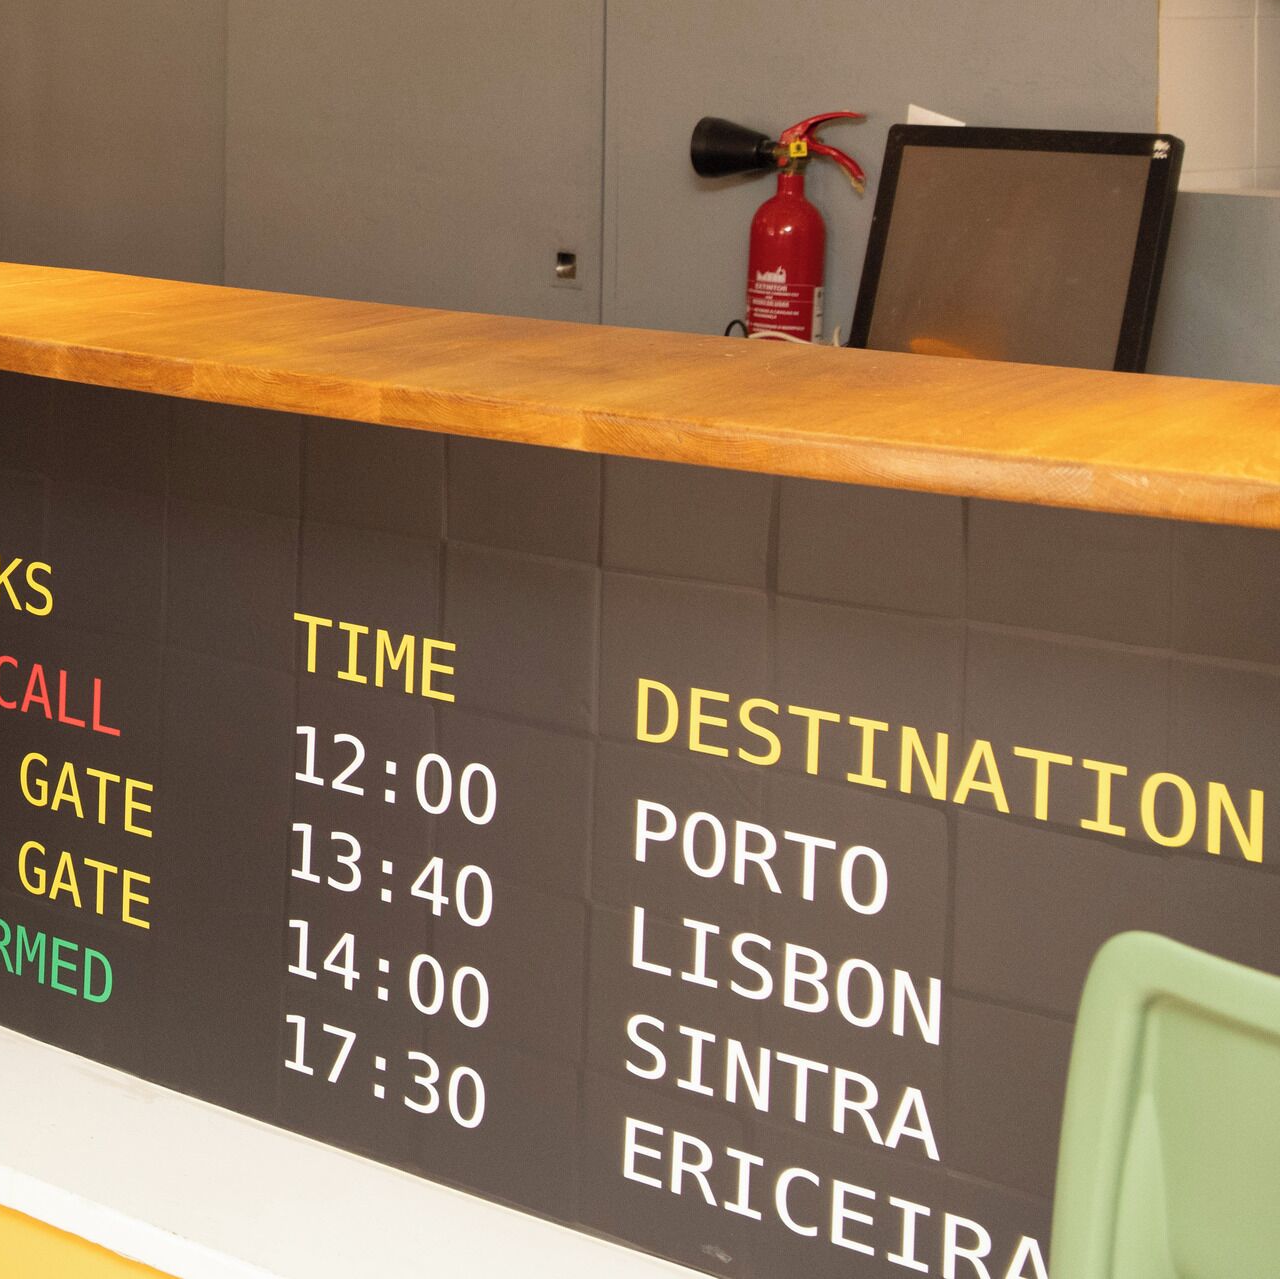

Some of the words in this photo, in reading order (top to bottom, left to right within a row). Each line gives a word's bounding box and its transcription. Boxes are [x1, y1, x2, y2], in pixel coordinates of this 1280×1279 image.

[20, 752, 155, 839] GATE
[293, 612, 457, 703] TIME
[635, 677, 1265, 863] DESTINATION
[293, 724, 498, 826] 12:00
[633, 798, 890, 916] PORTO
[16, 840, 154, 930] GATE
[289, 823, 494, 928] 13:40
[630, 906, 943, 1046] LISBON
[283, 1013, 486, 1129] 17:30
[622, 1116, 1049, 1279] ERICEIRA
[286, 919, 491, 1029] 14:00
[624, 1014, 942, 1162] SINTRA
